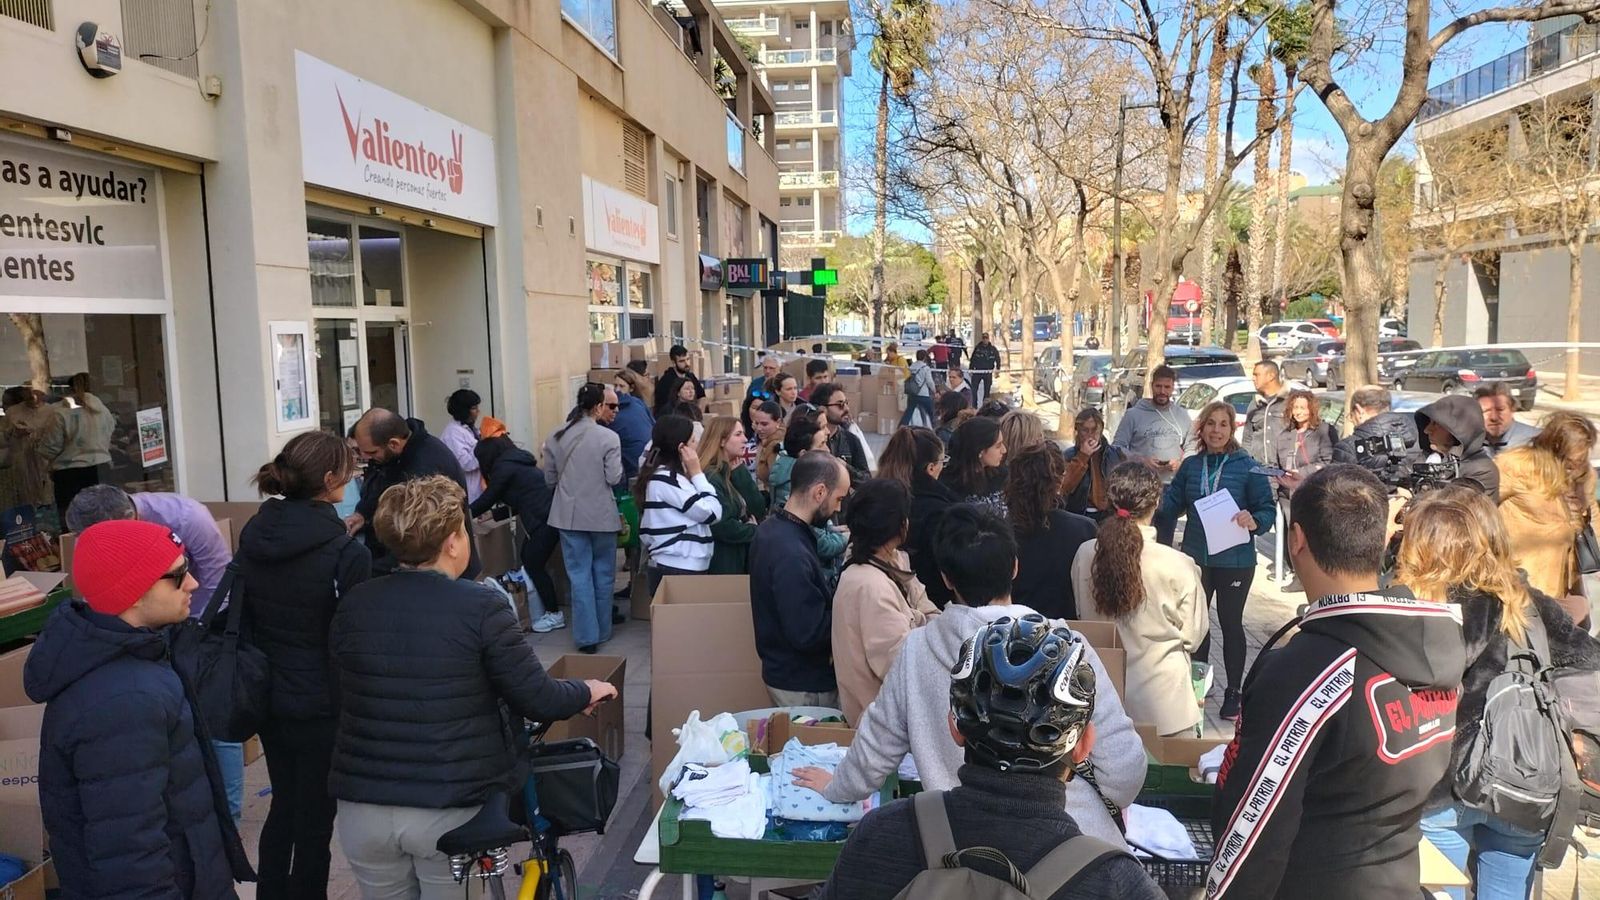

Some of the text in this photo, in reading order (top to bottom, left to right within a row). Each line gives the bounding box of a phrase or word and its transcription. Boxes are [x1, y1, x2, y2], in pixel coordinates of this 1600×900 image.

[334, 80, 447, 183] Valientes
[38, 166, 52, 189] a
[59, 170, 147, 204] ayudar?
[364, 163, 447, 202] Creando personas fuertes
[728, 264, 751, 283] BKL
[1310, 668, 1355, 709] EL PATRON
[1273, 717, 1311, 767] EL PATRON
[1242, 776, 1278, 823] EL PATRON
[1221, 830, 1247, 864] PATRON
